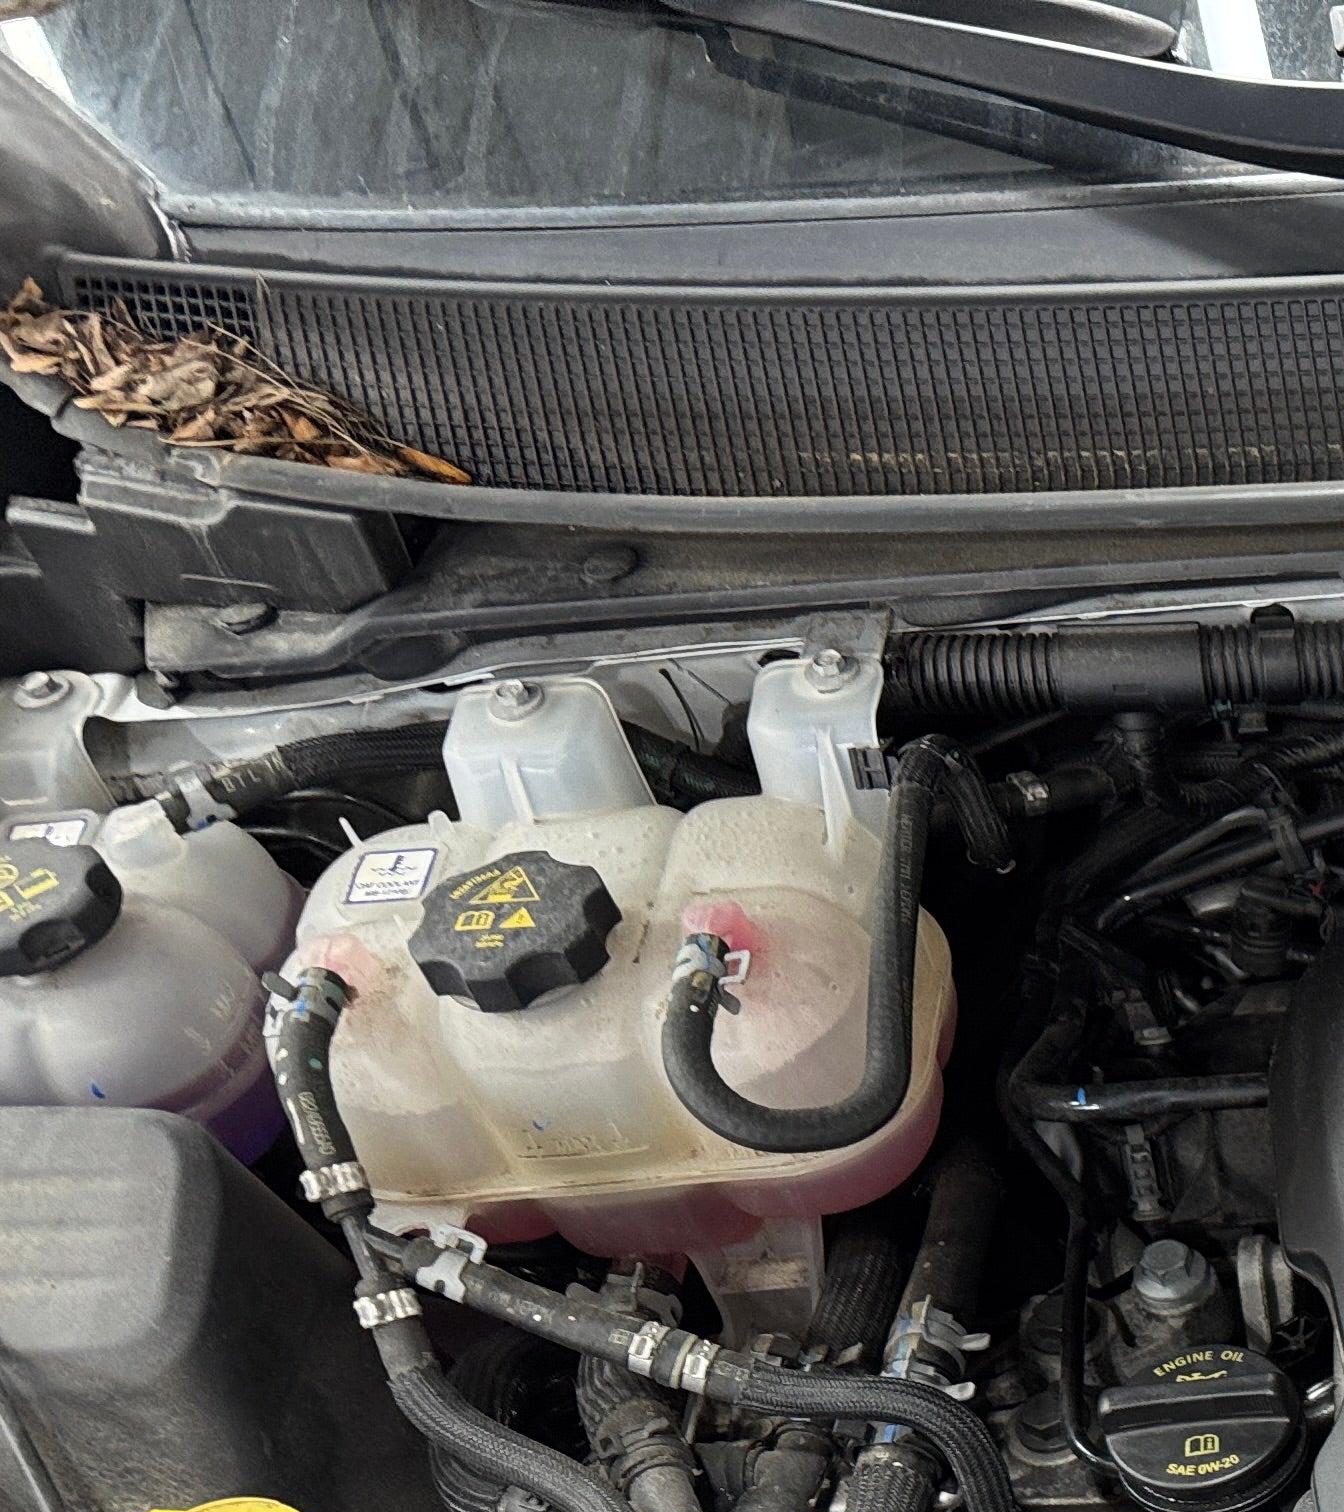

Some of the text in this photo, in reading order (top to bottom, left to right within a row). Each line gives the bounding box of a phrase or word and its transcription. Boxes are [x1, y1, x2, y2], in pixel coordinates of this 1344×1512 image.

[1153, 1350, 1244, 1377] ENGINE OIL
[1165, 1454, 1240, 1476] SAE 0W-20
